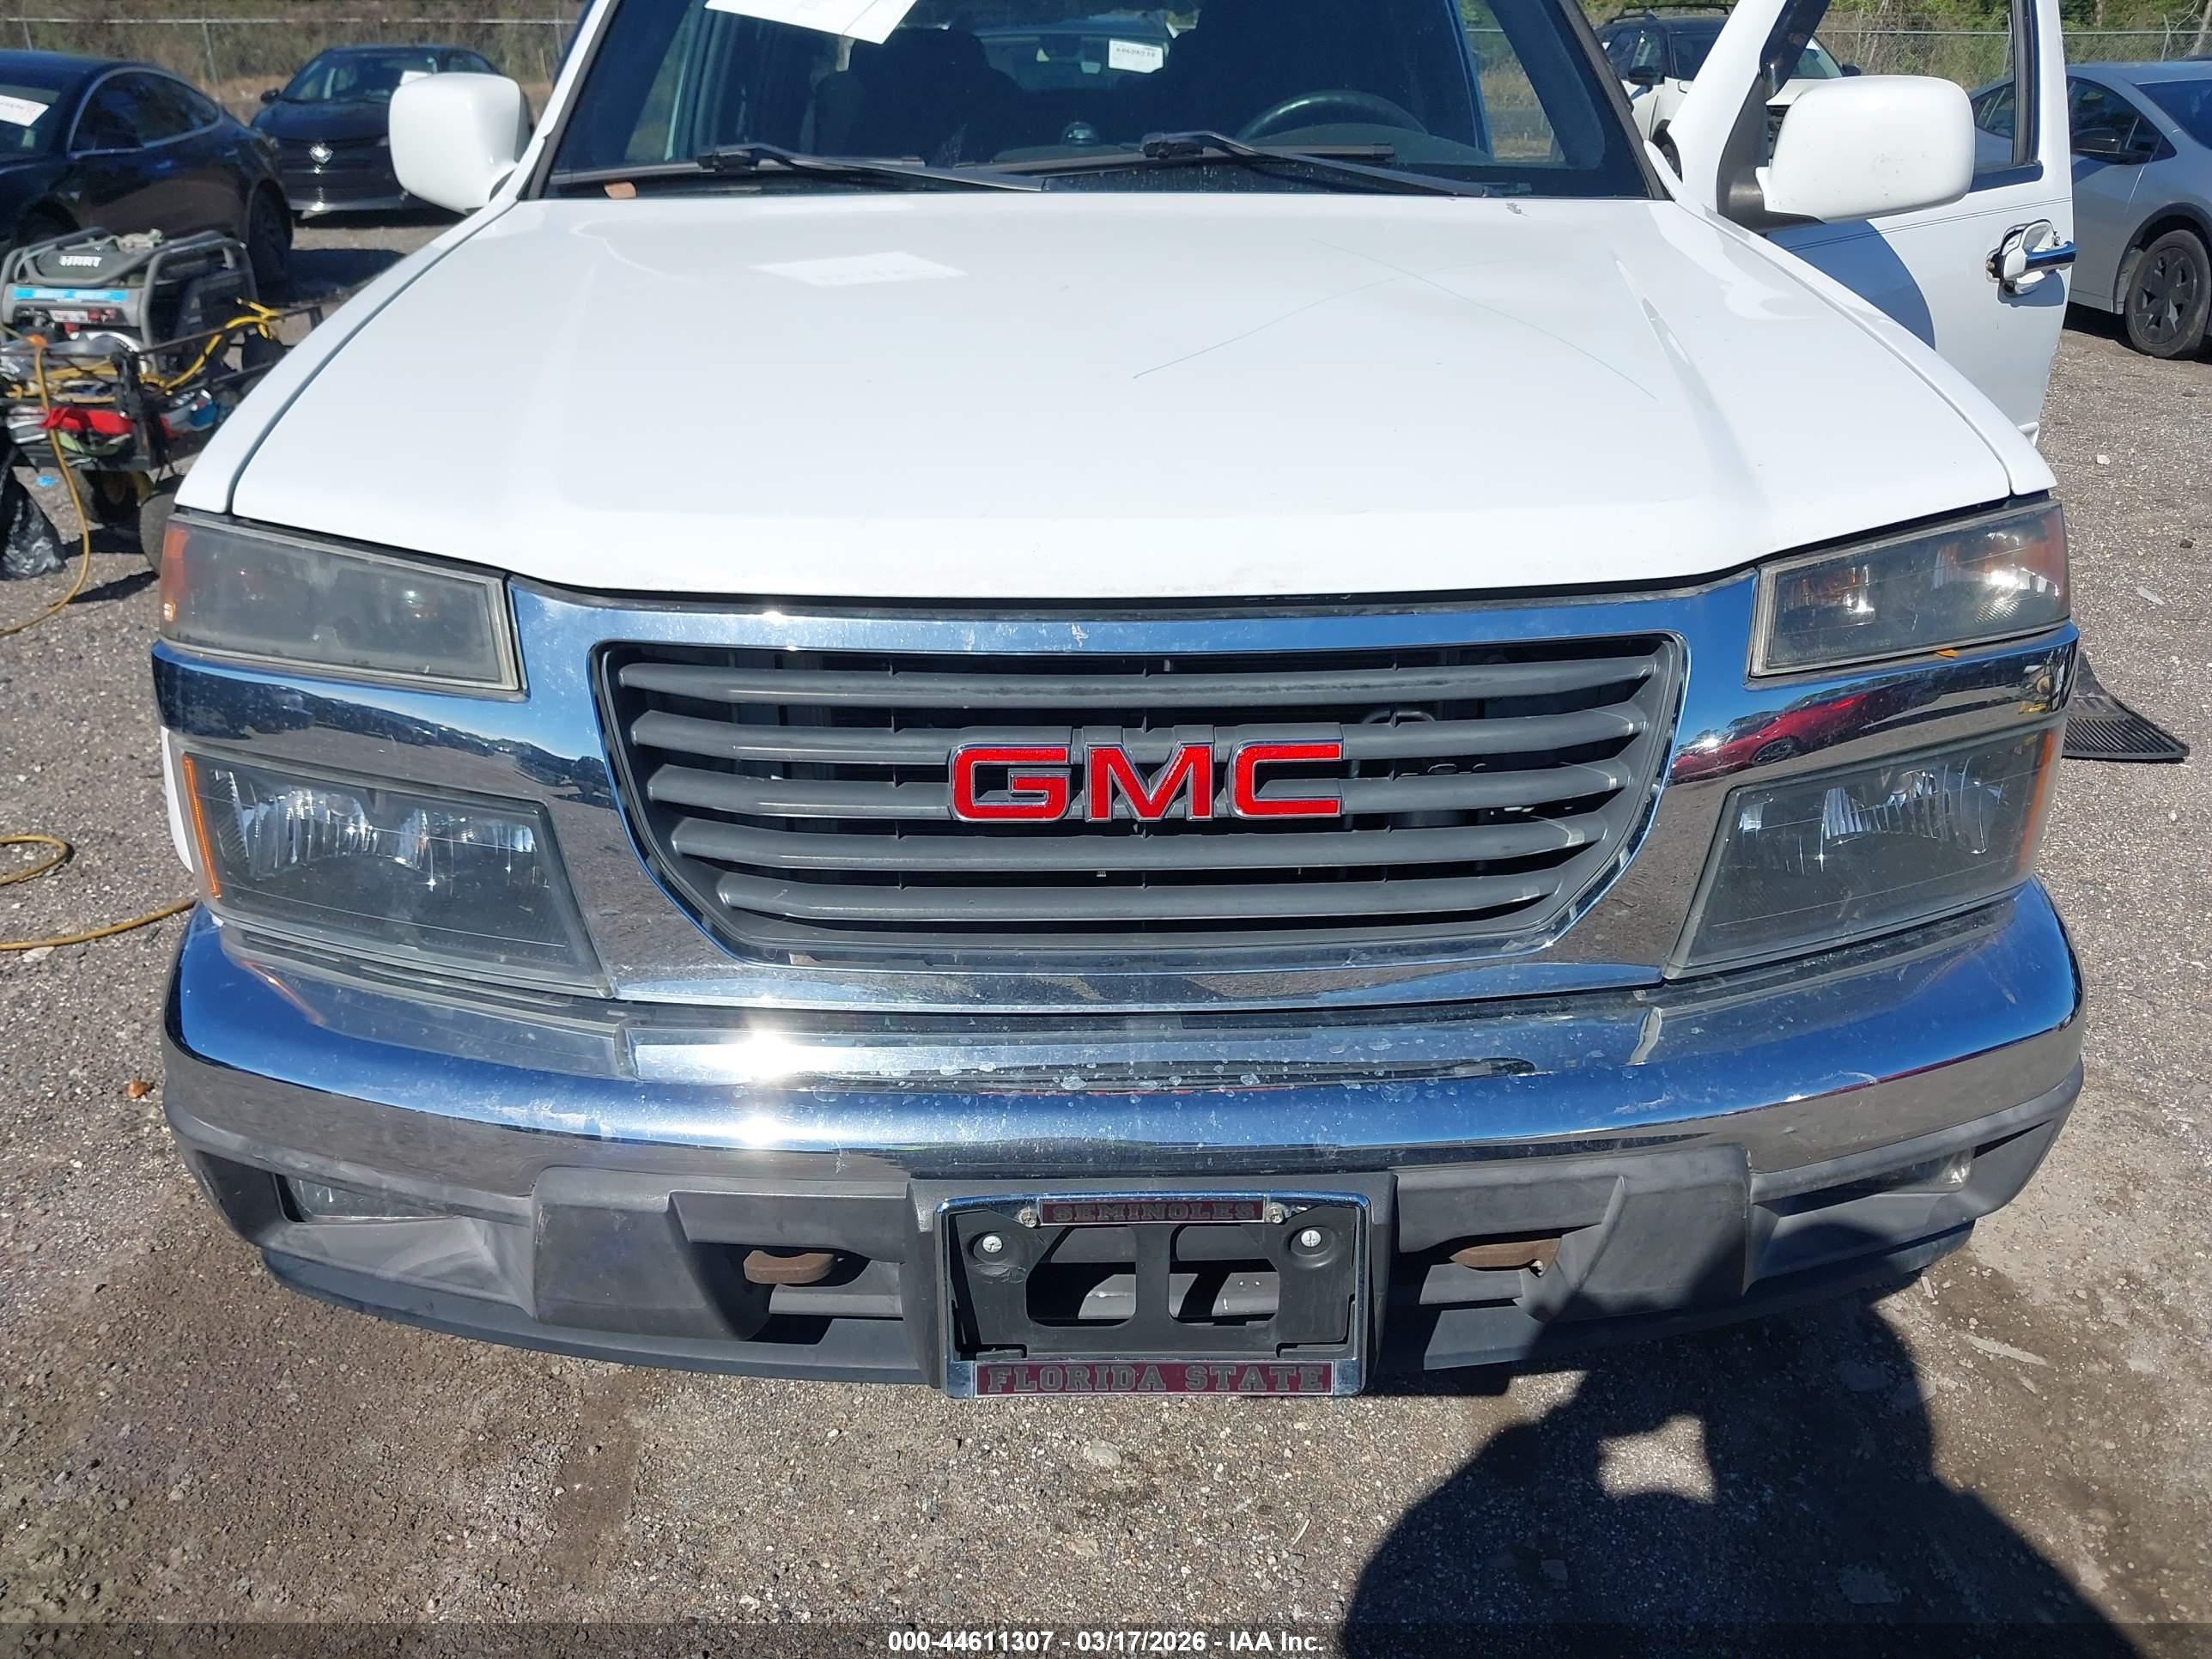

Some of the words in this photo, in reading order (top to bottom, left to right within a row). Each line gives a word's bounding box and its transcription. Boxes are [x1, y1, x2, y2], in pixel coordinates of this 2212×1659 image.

[949, 738, 1344, 823] GMC
[1053, 1203, 1255, 1222] SEMINOLES
[988, 1364, 1166, 1392] FLORIDA
[1185, 1365, 1328, 1392] STATE
